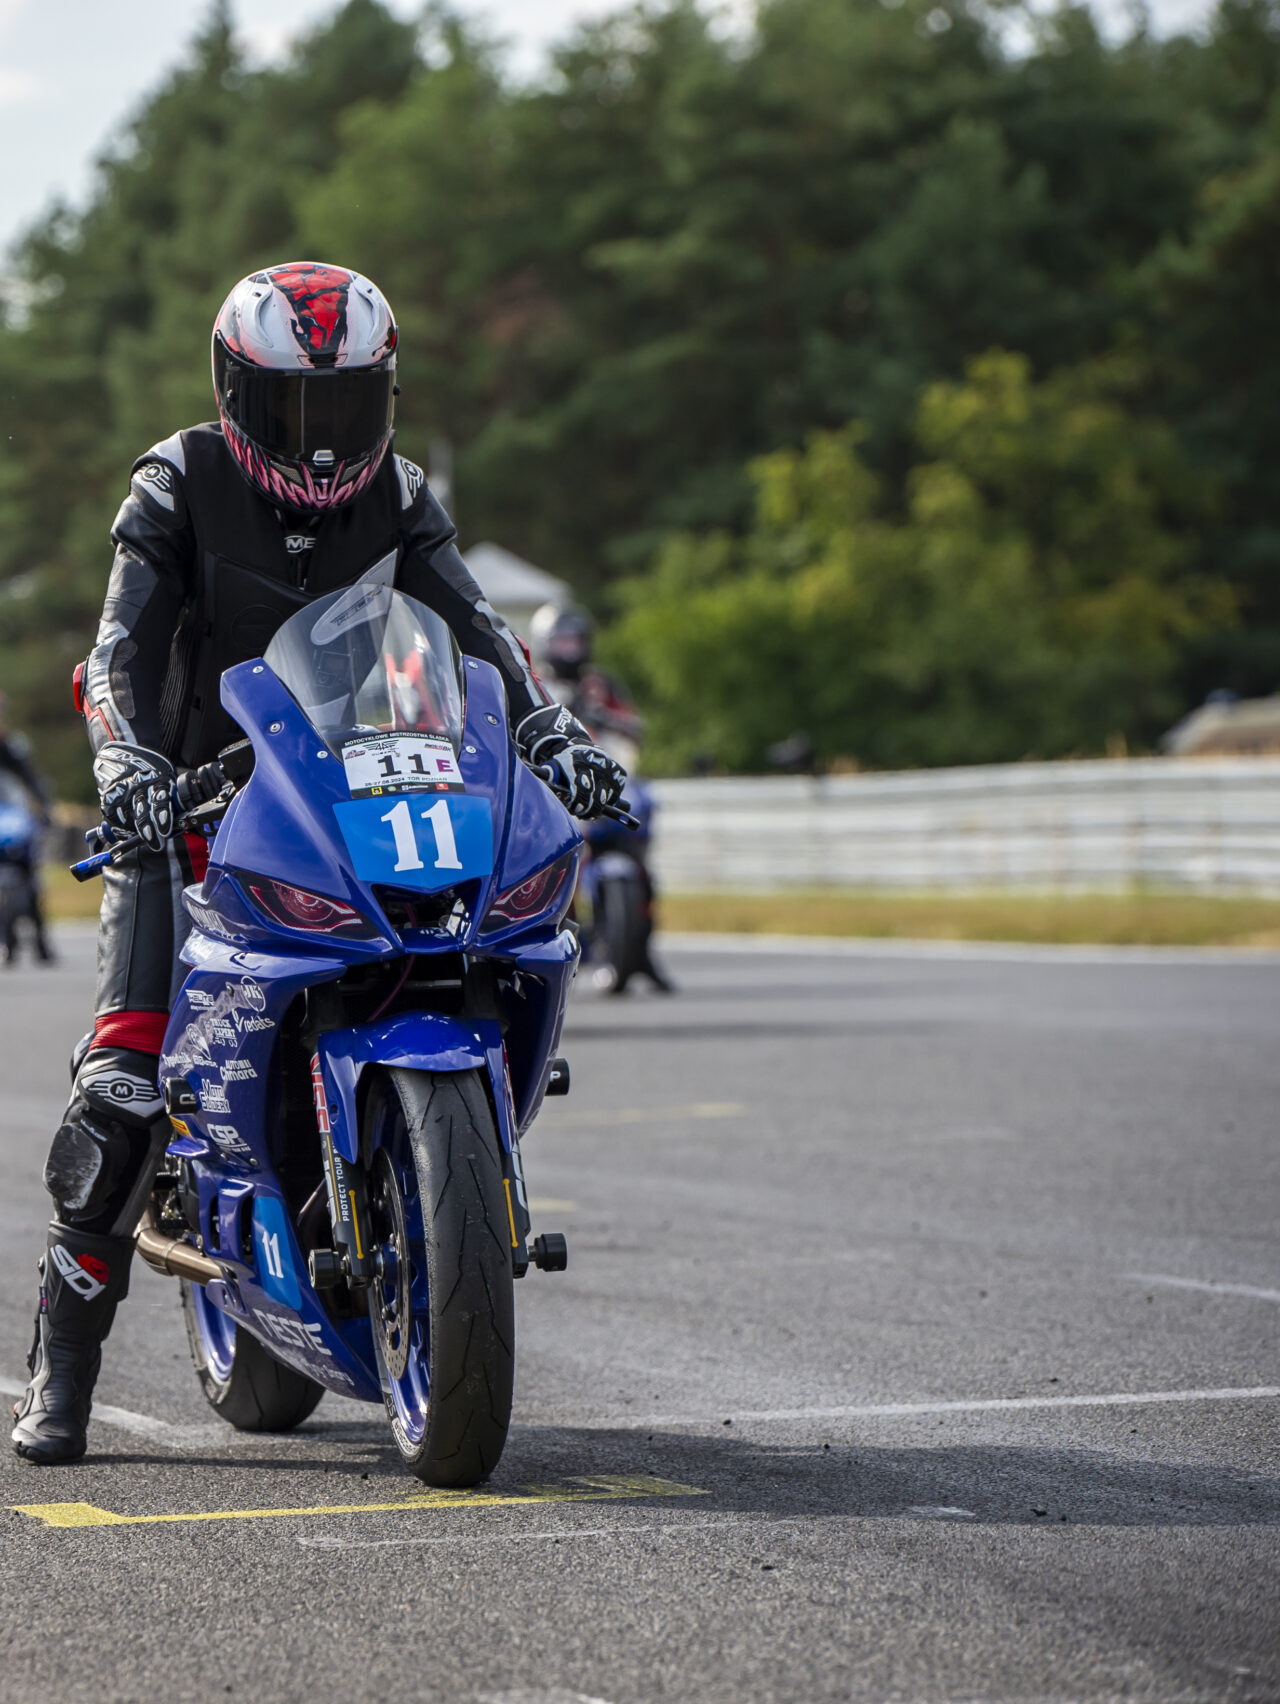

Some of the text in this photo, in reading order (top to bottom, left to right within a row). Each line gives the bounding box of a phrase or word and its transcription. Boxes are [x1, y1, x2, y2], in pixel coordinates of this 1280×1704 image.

[344, 734, 389, 747] MOTOCYKLOWE
[377, 753, 431, 778] 11
[435, 758, 454, 773] E
[380, 799, 463, 872] 11
[115, 1086, 129, 1095] M
[207, 1123, 239, 1145] CSP
[334, 1157, 344, 1181] YOUR
[337, 1183, 350, 1222] PROTECT
[261, 1231, 284, 1279] 11
